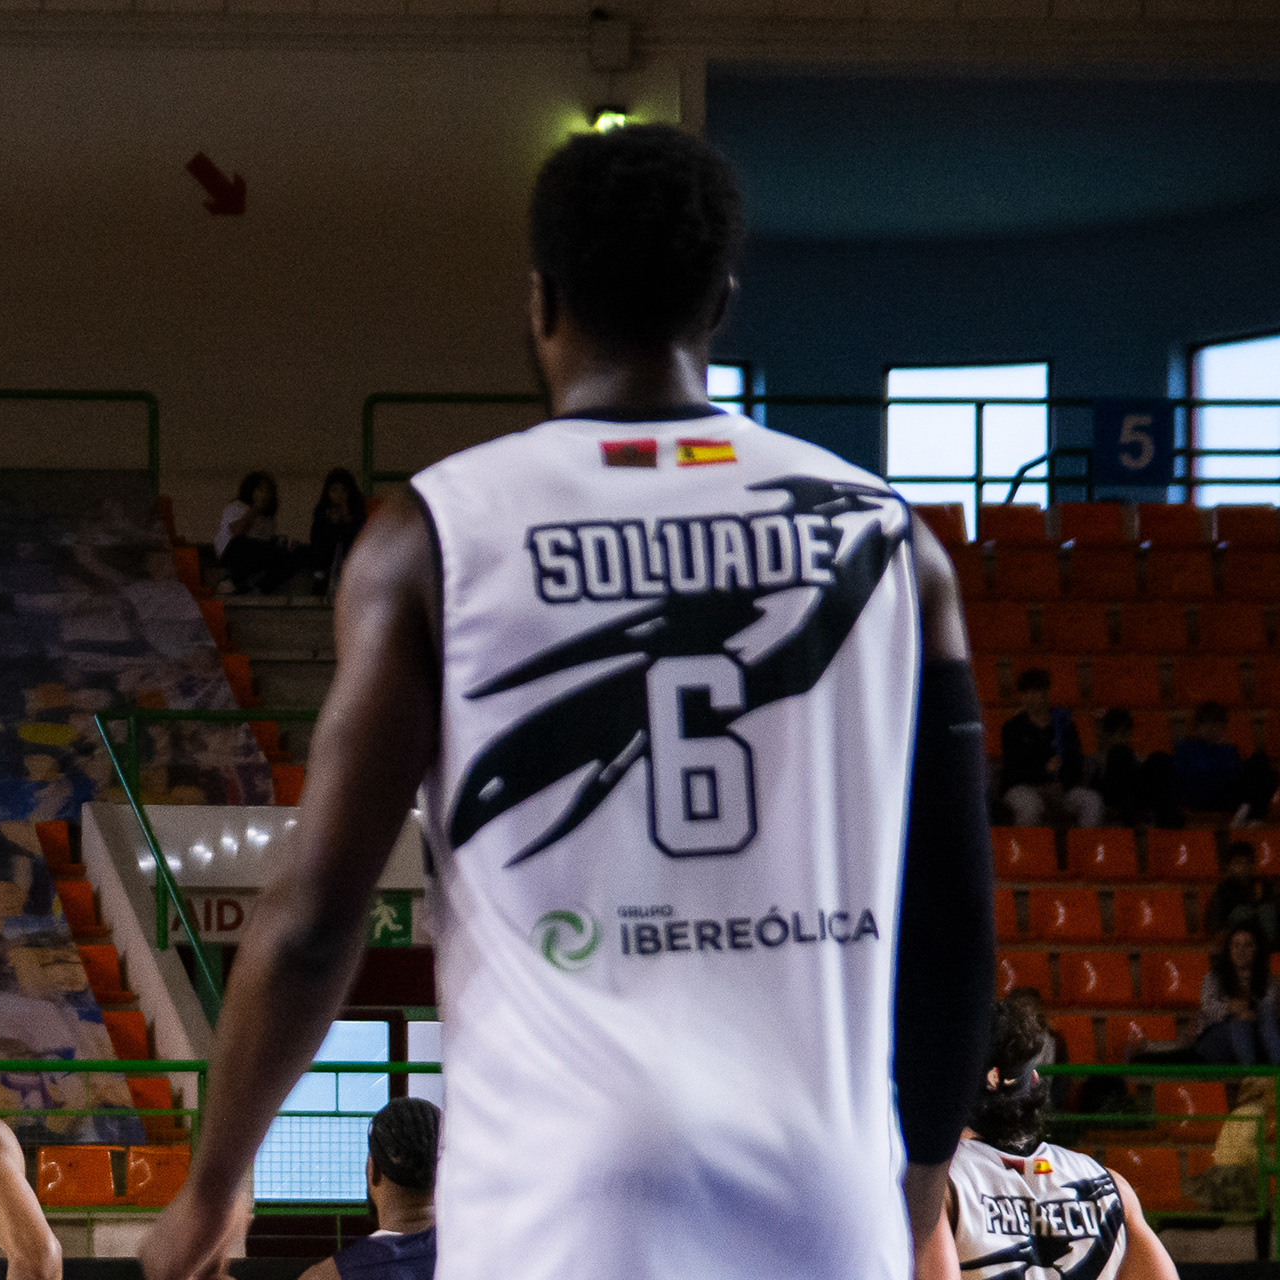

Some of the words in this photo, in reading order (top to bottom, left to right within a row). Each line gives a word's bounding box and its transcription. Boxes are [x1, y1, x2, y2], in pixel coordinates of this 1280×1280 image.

[1119, 413, 1154, 470] 5
[526, 514, 837, 604] SOLUADE
[647, 651, 758, 860] 6
[620, 905, 880, 956] IBEREÓLICA
